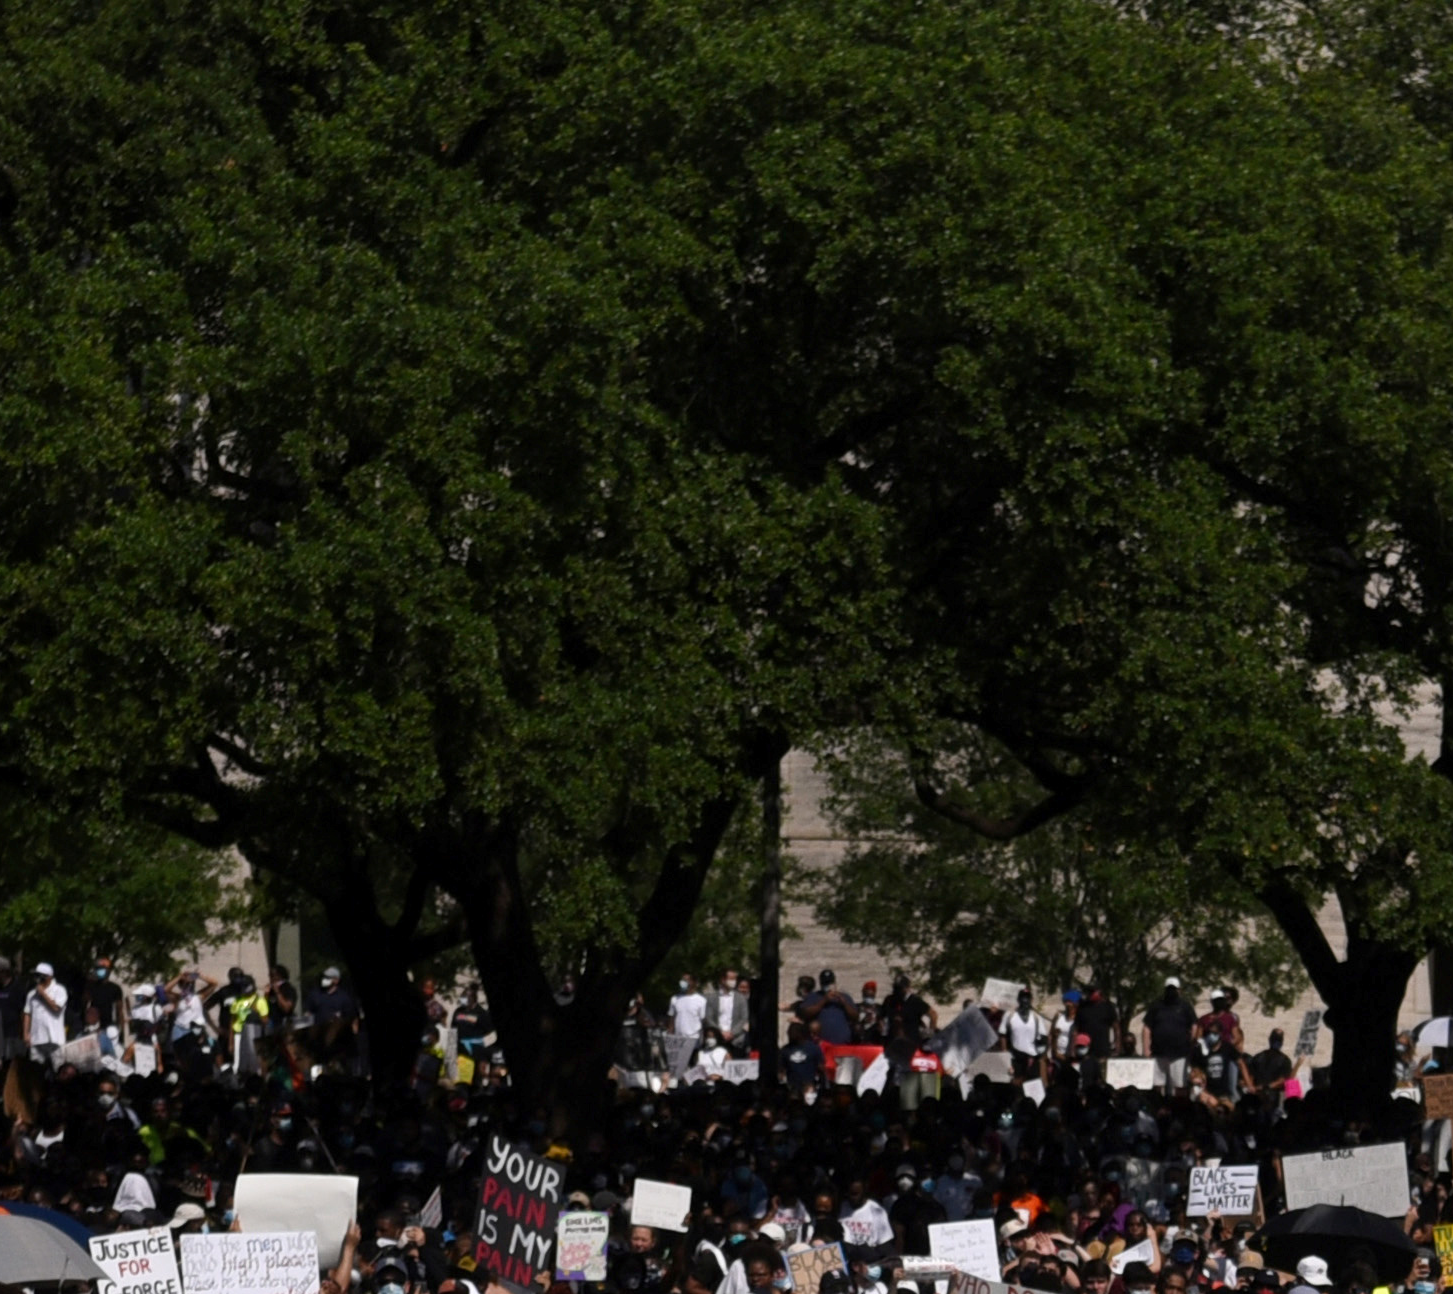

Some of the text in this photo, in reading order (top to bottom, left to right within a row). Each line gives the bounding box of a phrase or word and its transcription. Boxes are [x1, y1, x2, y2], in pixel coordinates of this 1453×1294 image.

[487, 1136, 560, 1204] YOUR
[1193, 1168, 1227, 1186] BLACK
[483, 1177, 546, 1229] PAIN
[1204, 1184, 1237, 1196] LIVES
[1207, 1193, 1251, 1209] MATTER
[93, 1236, 170, 1262] JUSTICE
[478, 1208, 498, 1245] IS
[509, 1223, 552, 1270] MY
[118, 1258, 151, 1278] FOR
[475, 1241, 533, 1287] PAIN
